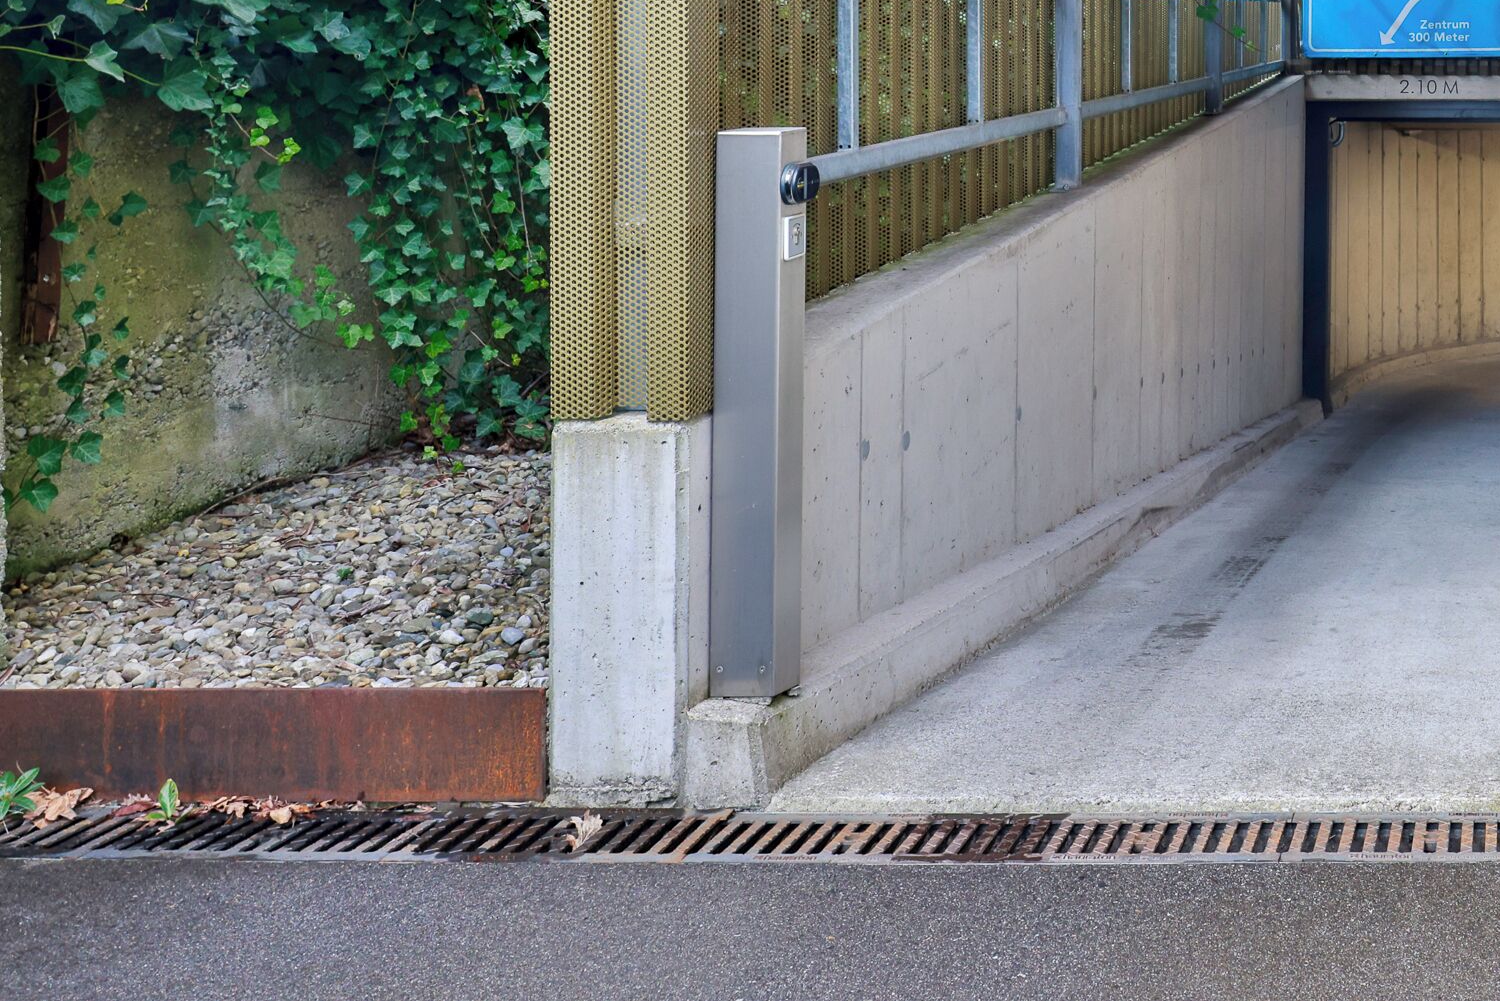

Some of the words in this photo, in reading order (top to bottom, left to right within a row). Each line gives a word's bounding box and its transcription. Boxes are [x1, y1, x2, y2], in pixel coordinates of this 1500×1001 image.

[1420, 20, 1470, 29] Zentrum
[1408, 32, 1431, 42] 300
[1434, 32, 1470, 42] Meter
[1399, 79, 1438, 94] 2.10
[1443, 80, 1459, 94] M
